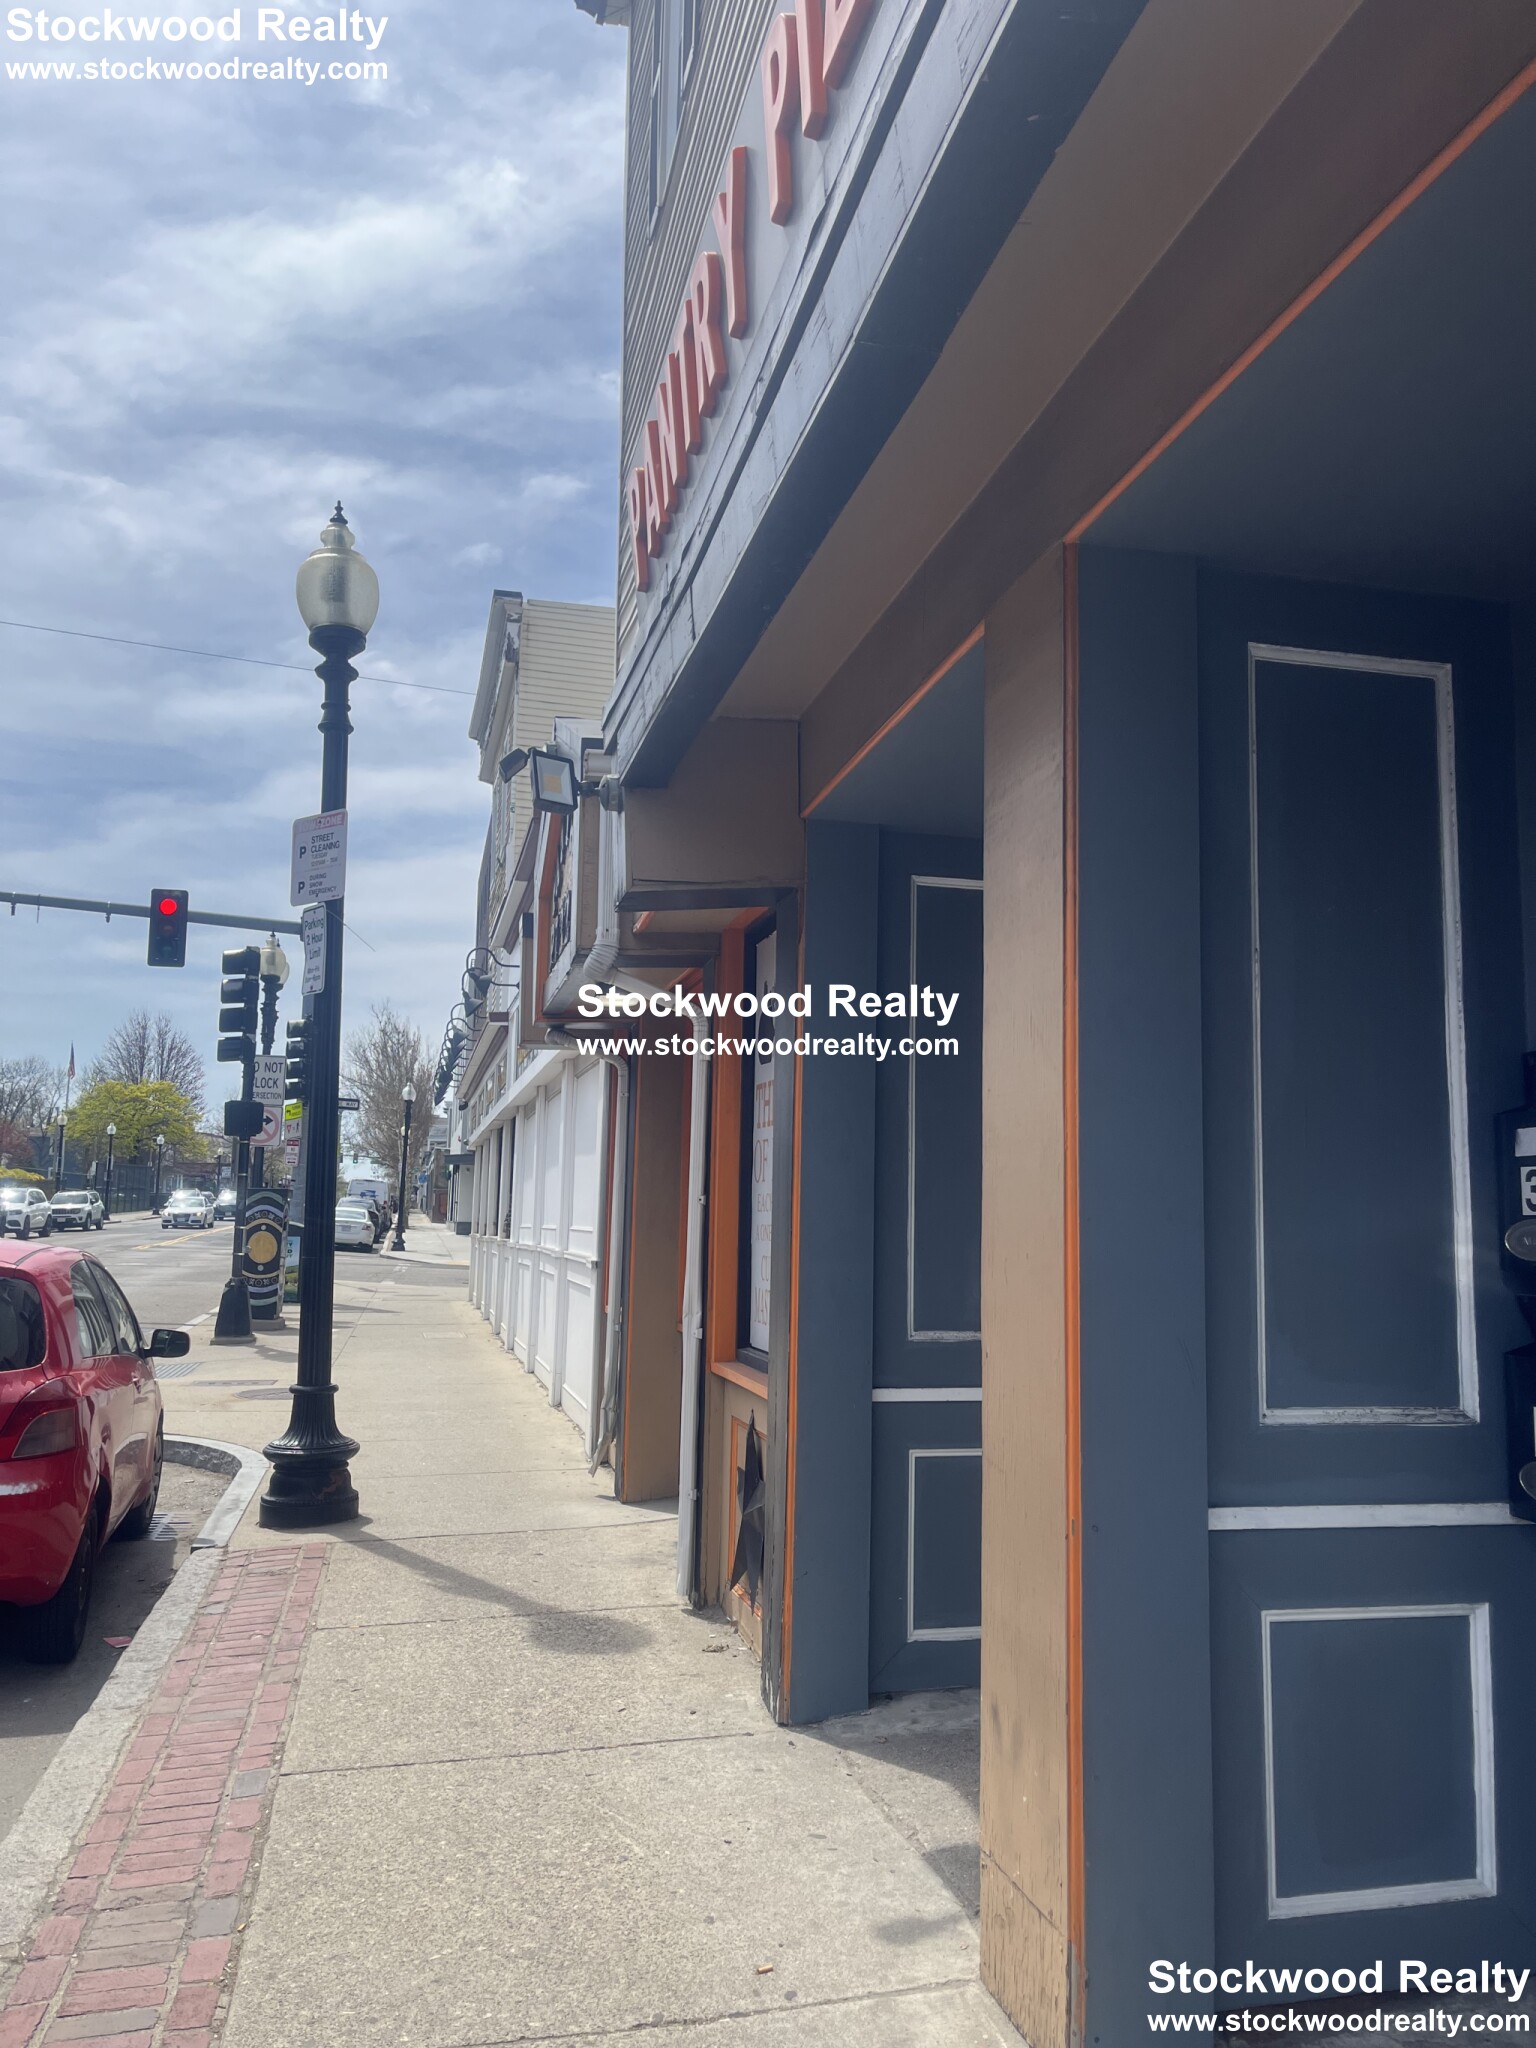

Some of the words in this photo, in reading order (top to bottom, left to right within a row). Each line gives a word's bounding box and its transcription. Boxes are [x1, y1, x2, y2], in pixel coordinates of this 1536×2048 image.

[627, 146, 749, 593] PANTRY
[761, 0, 874, 227] PI
[311, 832, 334, 844] STREET
[311, 841, 340, 853] CLEANING
[309, 872, 327, 881] DURING
[308, 886, 337, 896] EMERGENCY
[309, 881, 323, 889] SNOW
[305, 918, 324, 931] Parking
[306, 934, 311, 945] 2
[311, 933, 324, 944] Hour
[309, 947, 321, 960] Limit
[264, 1061, 284, 1073] NOT
[254, 1077, 279, 1089] LOCK
[252, 1091, 282, 1100] ERSECTION
[756, 1080, 774, 1129] TH
[754, 1138, 769, 1184] OF
